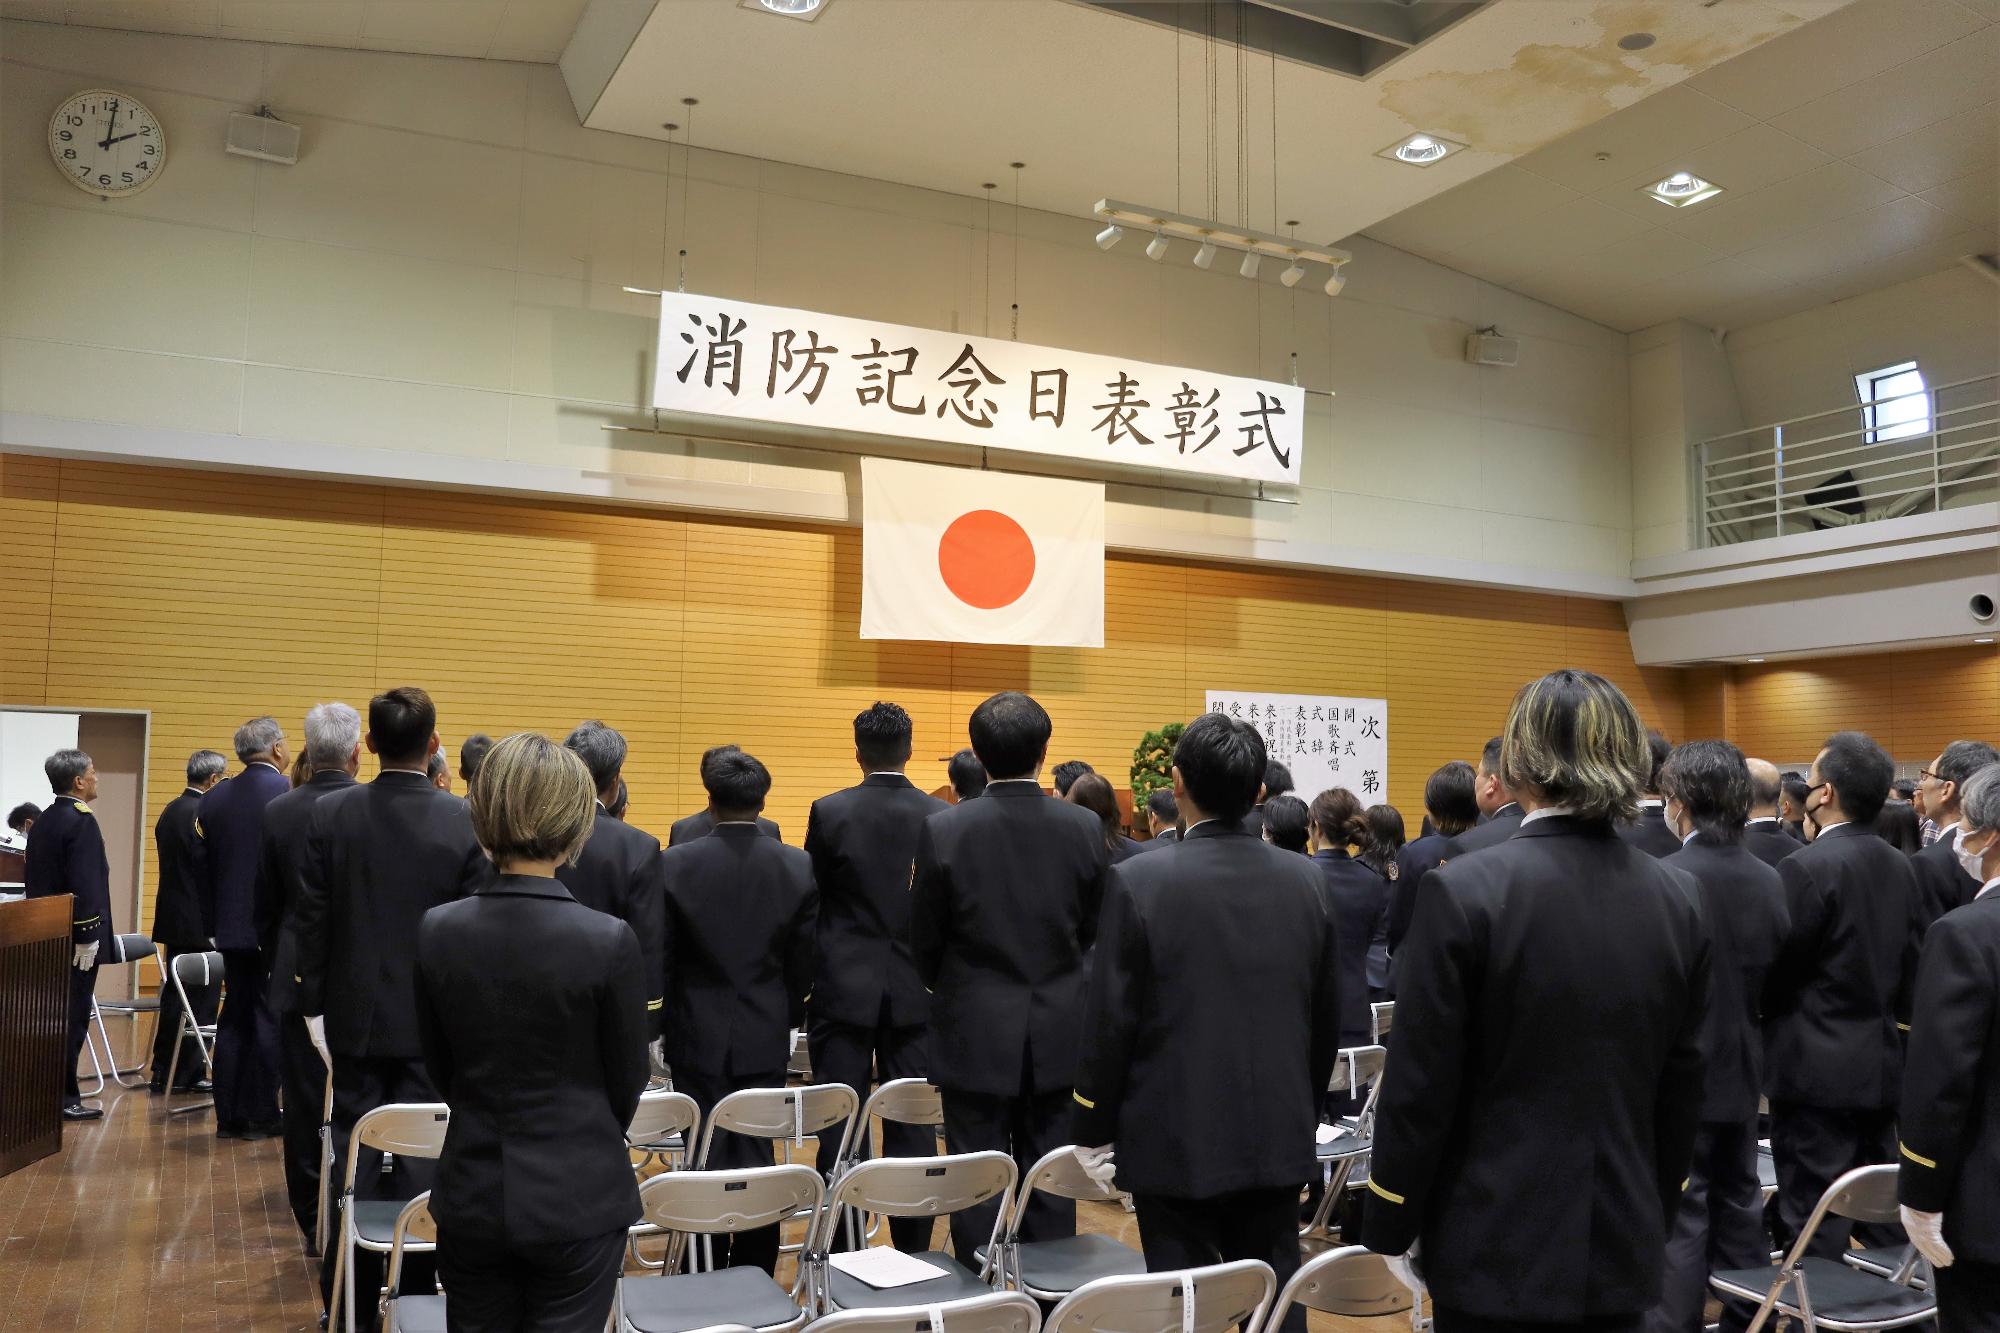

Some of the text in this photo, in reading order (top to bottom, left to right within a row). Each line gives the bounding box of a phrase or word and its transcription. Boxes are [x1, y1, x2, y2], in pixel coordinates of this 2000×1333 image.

[81, 103, 96, 115] 11
[103, 100, 119, 112] 12
[66, 115, 83, 126] 10
[129, 110, 134, 120] 1
[59, 130, 73, 141] 9
[138, 125, 151, 137] 2
[63, 148, 77, 160] 8
[144, 144, 155, 156] 3
[79, 166, 91, 177] 7
[135, 160, 149, 171] 4
[98, 174, 112, 185] 6
[121, 172, 134, 183] 5
[676, 311, 1291, 470] 消防記念日表彰式
[1263, 703, 1278, 760] 来賓祝
[1295, 705, 1307, 755] 表彰式
[1328, 707, 1340, 772] 国歌斉唱
